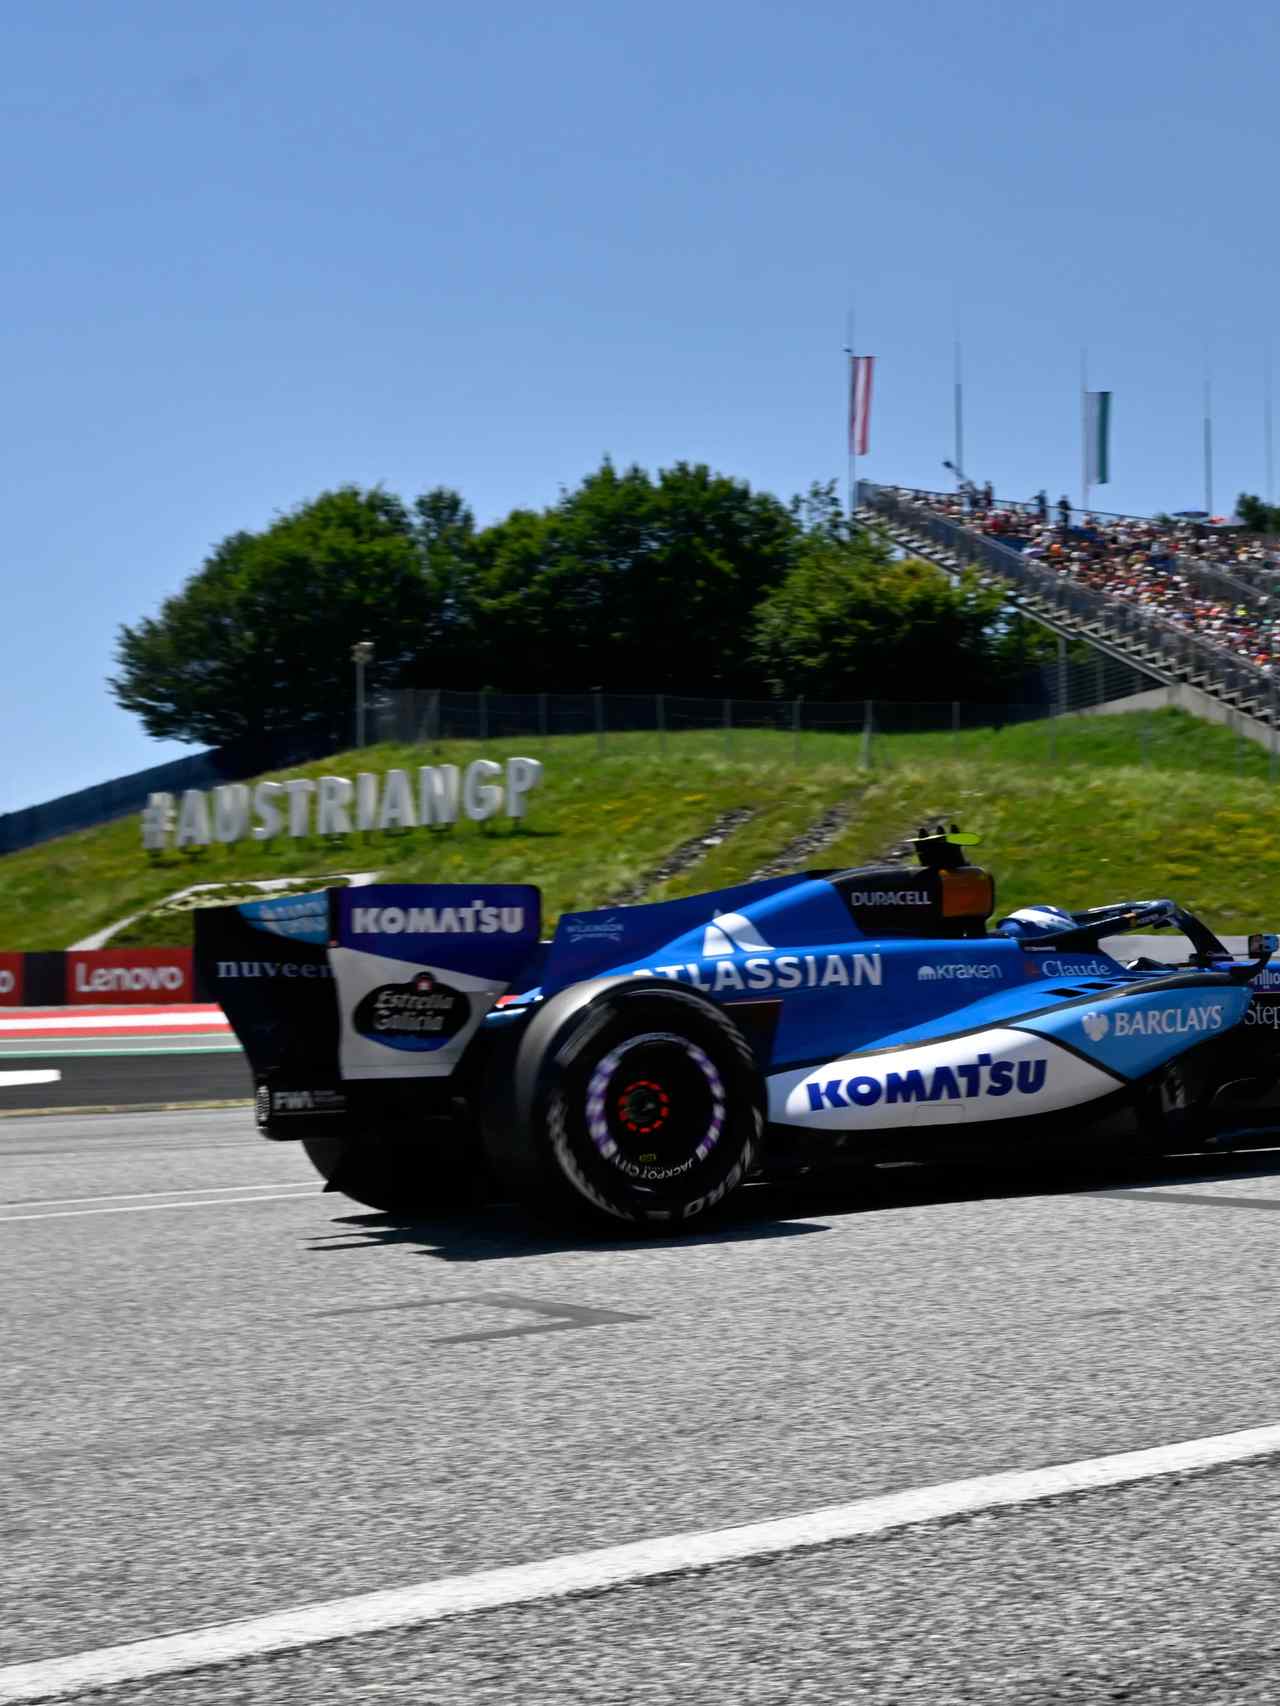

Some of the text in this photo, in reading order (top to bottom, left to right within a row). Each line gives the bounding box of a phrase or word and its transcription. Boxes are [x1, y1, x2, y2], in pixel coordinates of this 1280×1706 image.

[852, 890, 932, 907] DURACELL
[351, 899, 524, 934] KOMATSU
[75, 962, 184, 993] Lenovo
[633, 953, 882, 992] TLASSIAN
[936, 964, 1003, 980] kraken
[1042, 960, 1112, 977] Claude
[1114, 1004, 1223, 1037] BARCLAYS
[806, 1053, 1048, 1112] KOMATSU
